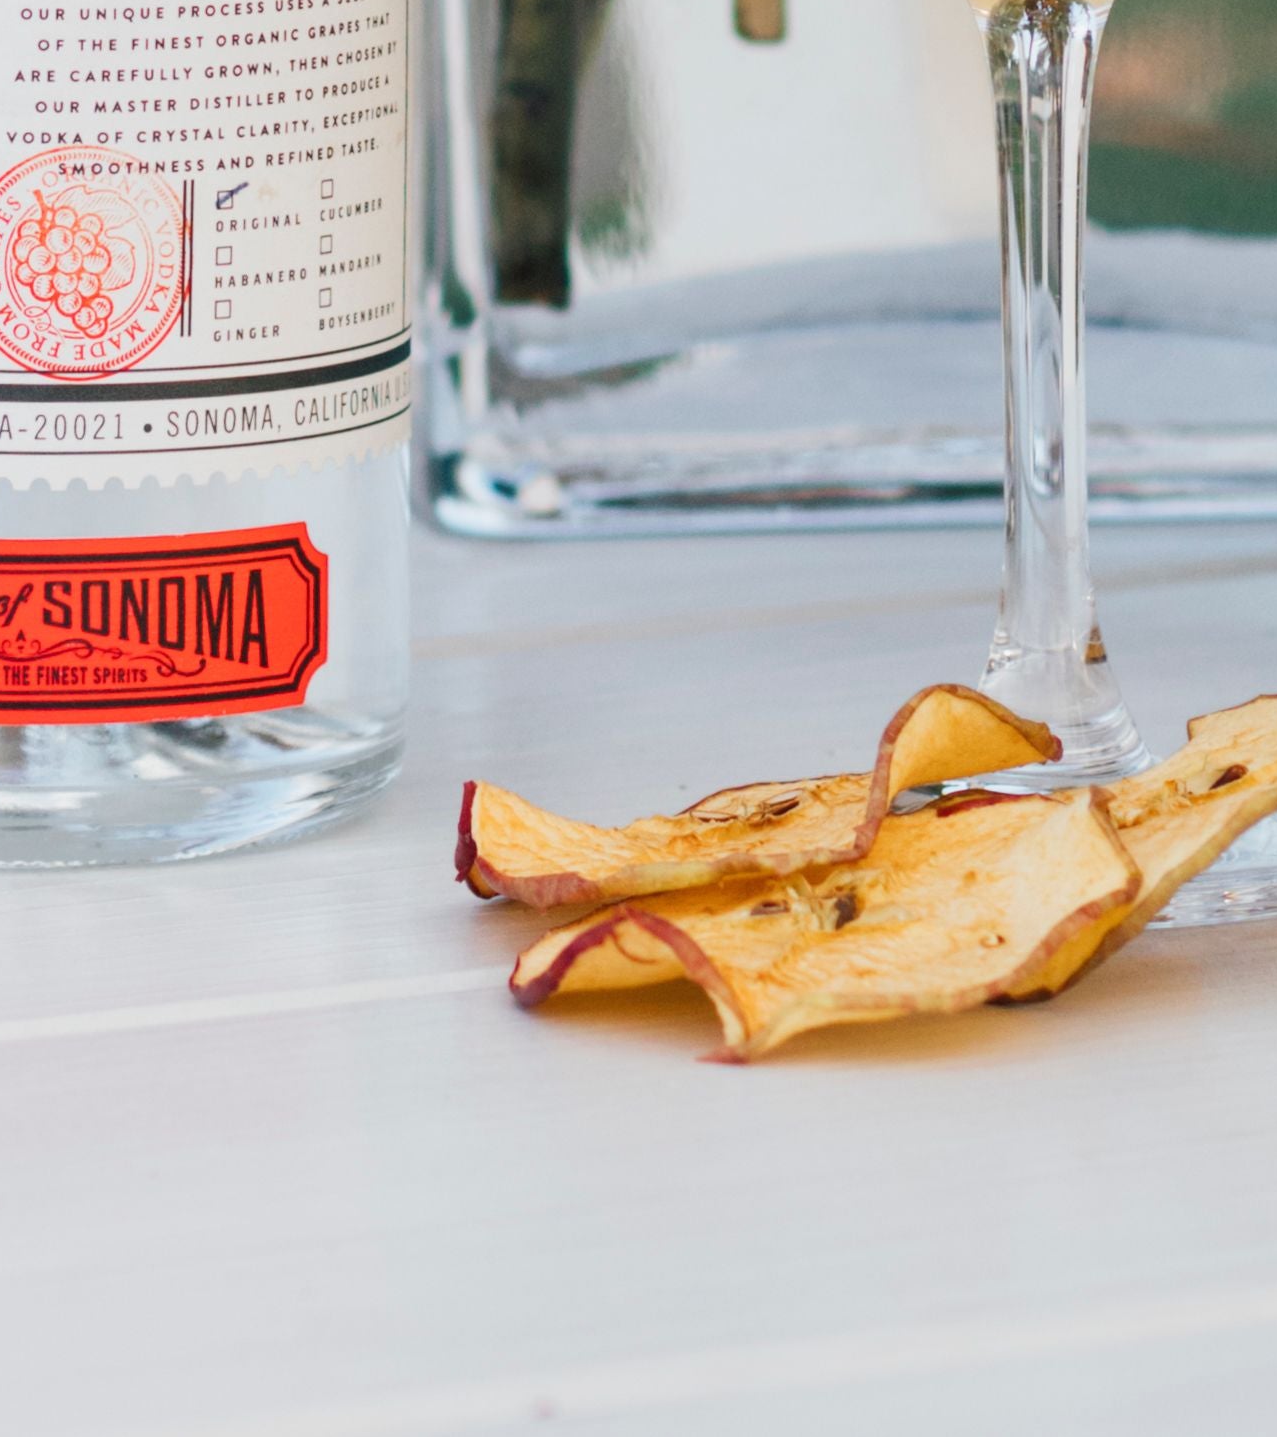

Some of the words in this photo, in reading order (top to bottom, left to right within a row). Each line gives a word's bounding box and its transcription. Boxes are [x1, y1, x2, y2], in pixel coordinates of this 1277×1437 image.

[20, 7, 65, 21] OUR
[79, 6, 165, 23] UNIQUE
[177, 1, 265, 19] PROCESS
[37, 39, 65, 52] OF
[77, 38, 118, 52] THE
[131, 36, 204, 51] FINEST
[216, 28, 299, 48] ORGANIC
[308, 19, 360, 40] GRAPES
[366, 12, 390, 29] THAT
[14, 69, 56, 83] ARE
[69, 67, 193, 83] CAREFULLY
[204, 62, 281, 79] GROWN,
[289, 55, 329, 73] THEN
[336, 41, 383, 66] CHOSEN
[35, 100, 80, 114] OUR
[93, 99, 178, 114] MASTER
[189, 91, 286, 111] DISTILLER
[295, 88, 314, 102] TO
[322, 74, 380, 99] PRODUCE
[384, 73, 390, 86] A
[6, 131, 83, 145] VODKA
[96, 131, 123, 144] OF
[136, 128, 225, 144] CRYSTAL
[236, 119, 315, 139] CLARITY,
[323, 101, 398, 129] EXCEPTIONAL
[58, 158, 205, 175] SMOOTHNESS
[216, 156, 255, 171] AND
[266, 145, 335, 167] REFINED
[342, 137, 379, 157] TASTE.
[215, 213, 302, 233] ORIGINAL
[319, 197, 383, 222] CUCUMBER
[145, 219, 175, 315] VODKA
[215, 267, 307, 289] HABANERO
[319, 253, 382, 277] MANDARIN
[213, 324, 281, 343] GINGER
[319, 302, 395, 331] BOYSENBERRY
[73, 319, 145, 361] MADE
[165, 403, 282, 437] SONOMA,
[294, 379, 391, 427] CALIFORNIA
[42, 569, 270, 669] SONOMA
[2, 666, 30, 686] THE
[36, 666, 88, 686] FINEST
[93, 666, 148, 685] SPIRITS
